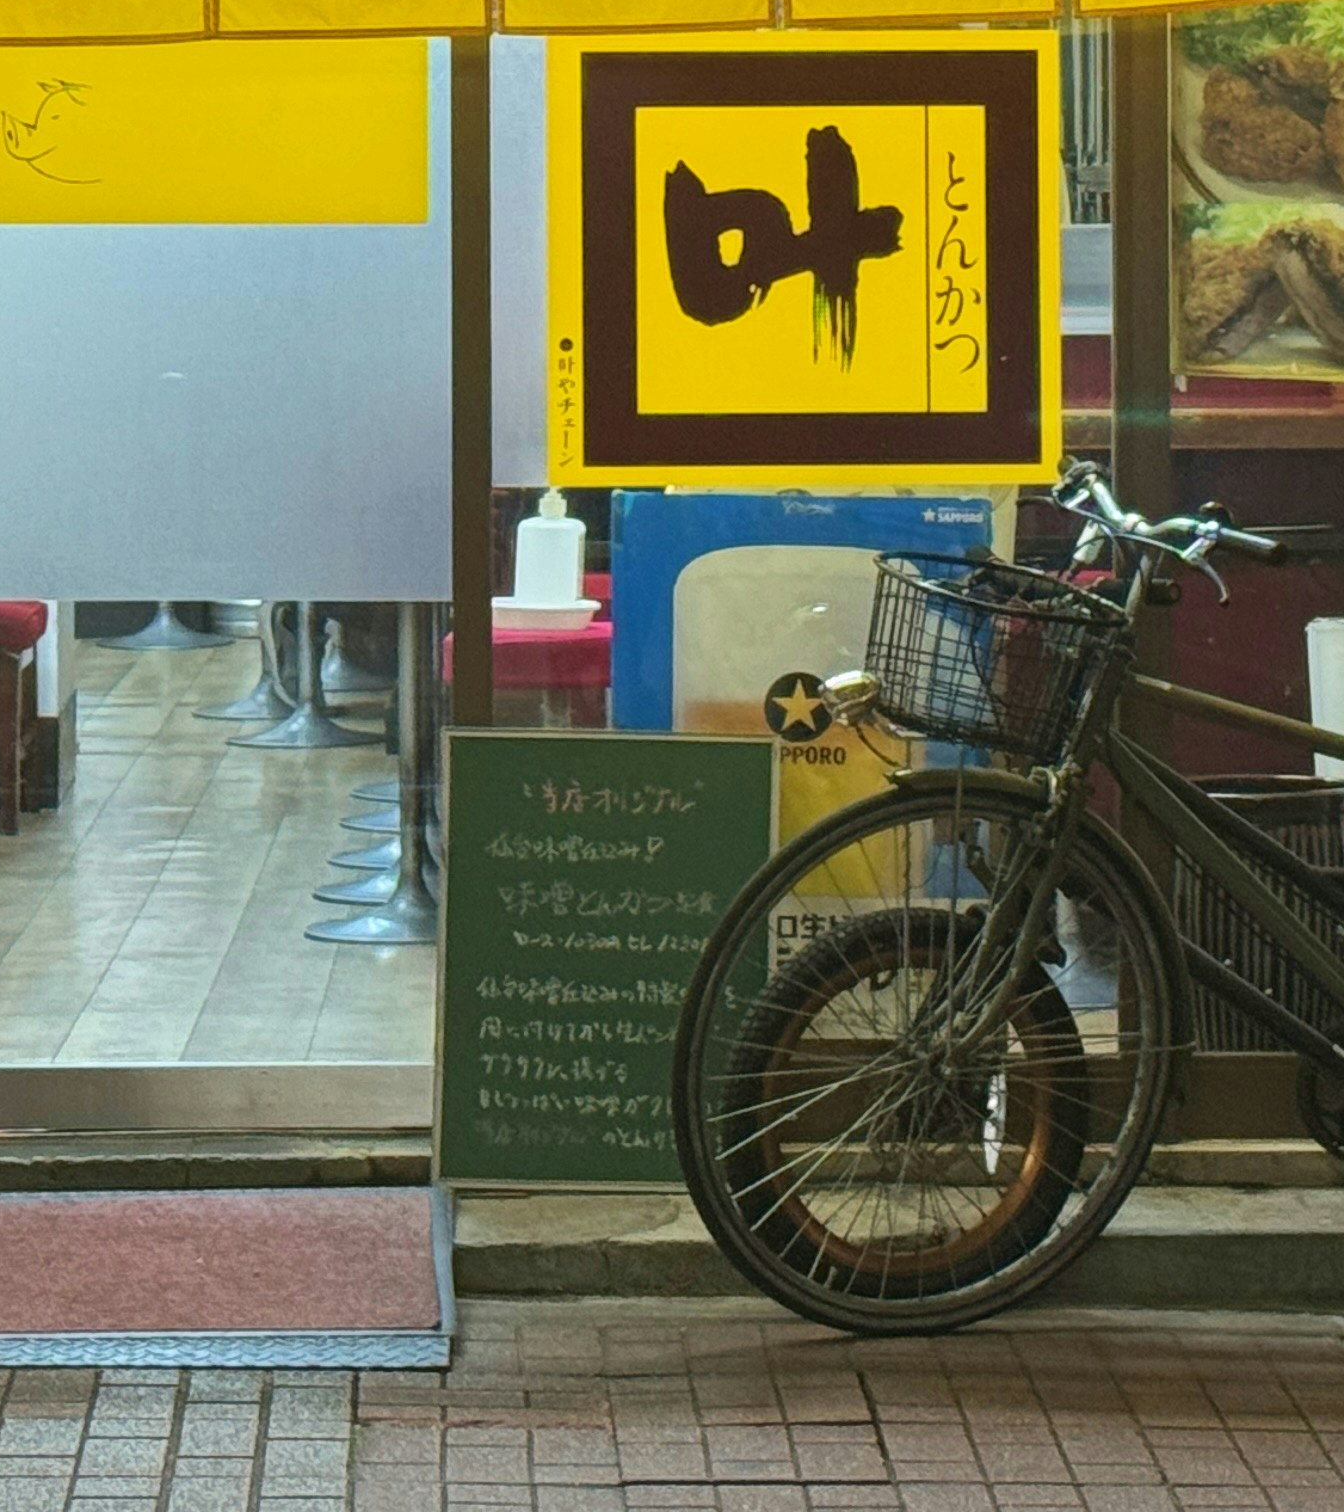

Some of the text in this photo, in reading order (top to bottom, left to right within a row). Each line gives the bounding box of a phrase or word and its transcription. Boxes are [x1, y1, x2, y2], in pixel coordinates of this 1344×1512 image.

[663, 125, 905, 374] 叶
[934, 151, 981, 374] とんかつ
